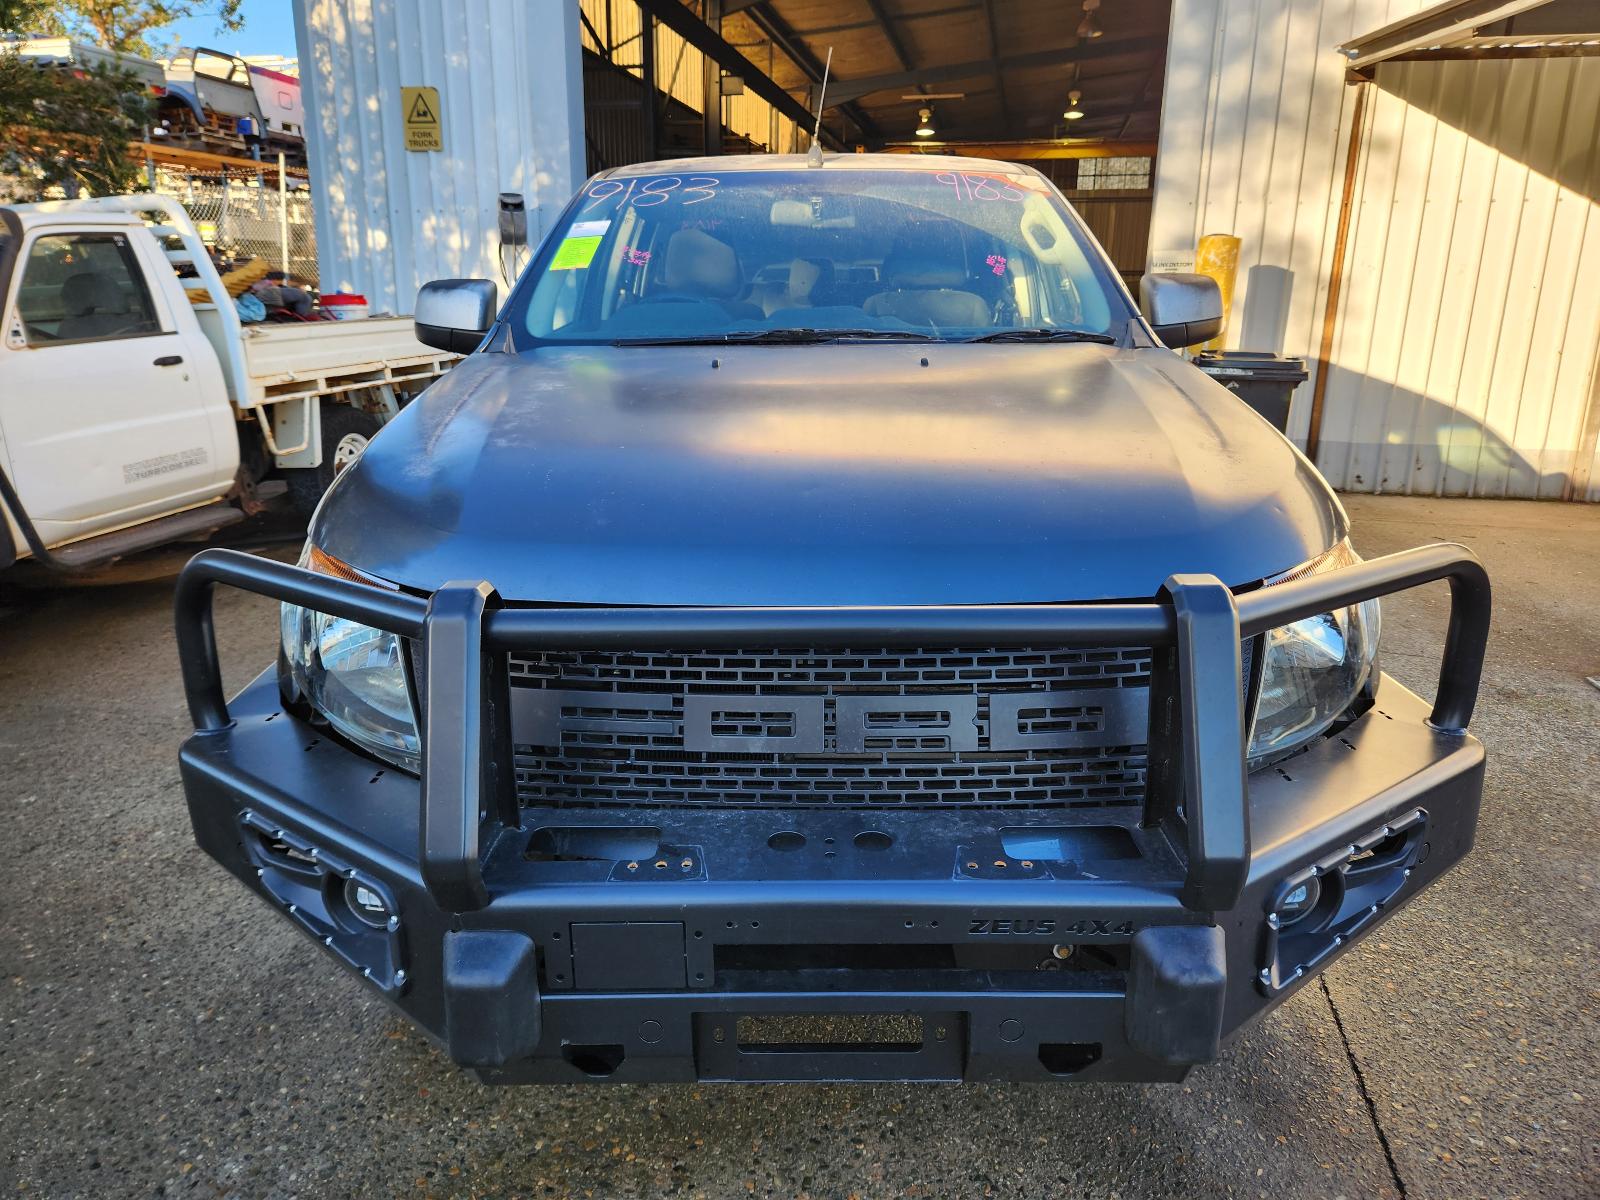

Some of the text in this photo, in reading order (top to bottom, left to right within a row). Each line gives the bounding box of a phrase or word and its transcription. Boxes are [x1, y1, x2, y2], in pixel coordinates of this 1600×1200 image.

[412, 131, 433, 139] FORK
[408, 140, 439, 148] TRUCKS
[583, 177, 720, 214] 9183
[935, 173, 1025, 202] 9183
[968, 919, 1137, 936] ZEUS 4X4
